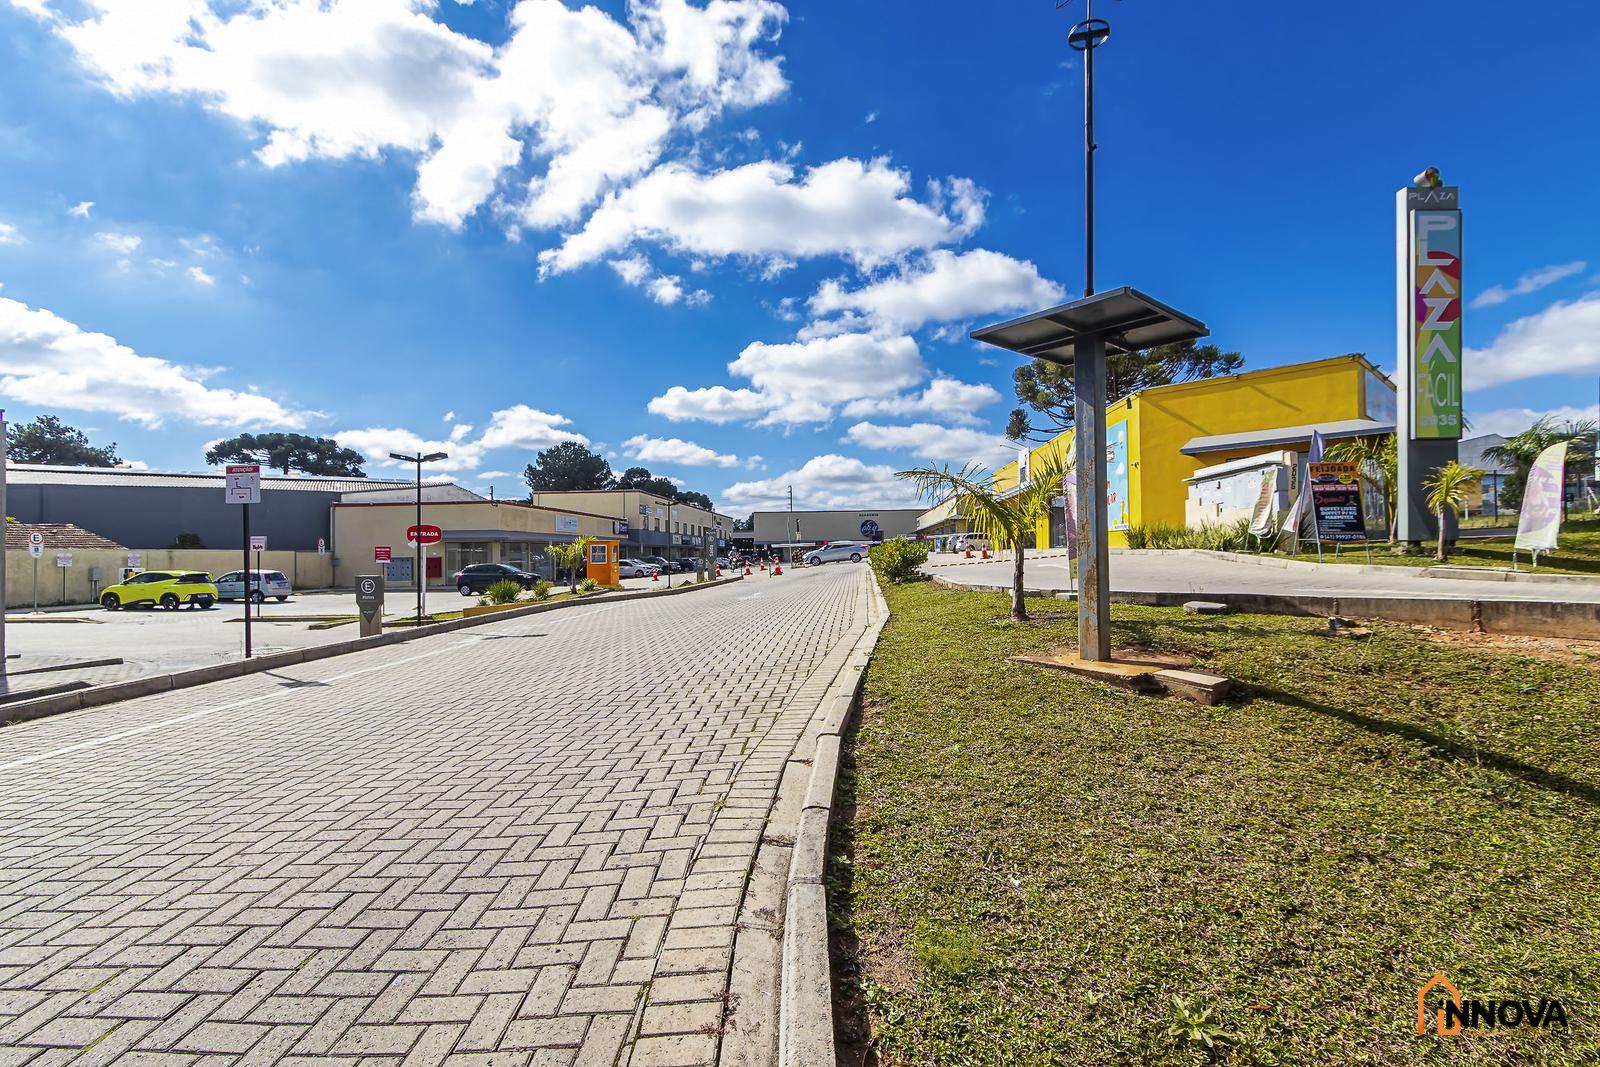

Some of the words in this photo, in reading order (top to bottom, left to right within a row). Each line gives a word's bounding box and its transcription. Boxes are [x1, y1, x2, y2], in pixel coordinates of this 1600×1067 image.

[1408, 191, 1456, 203] PLAZA
[1418, 215, 1457, 362] PLAZA
[1416, 360, 1459, 407] FÁCIL
[1310, 465, 1356, 473] FEIJOADA
